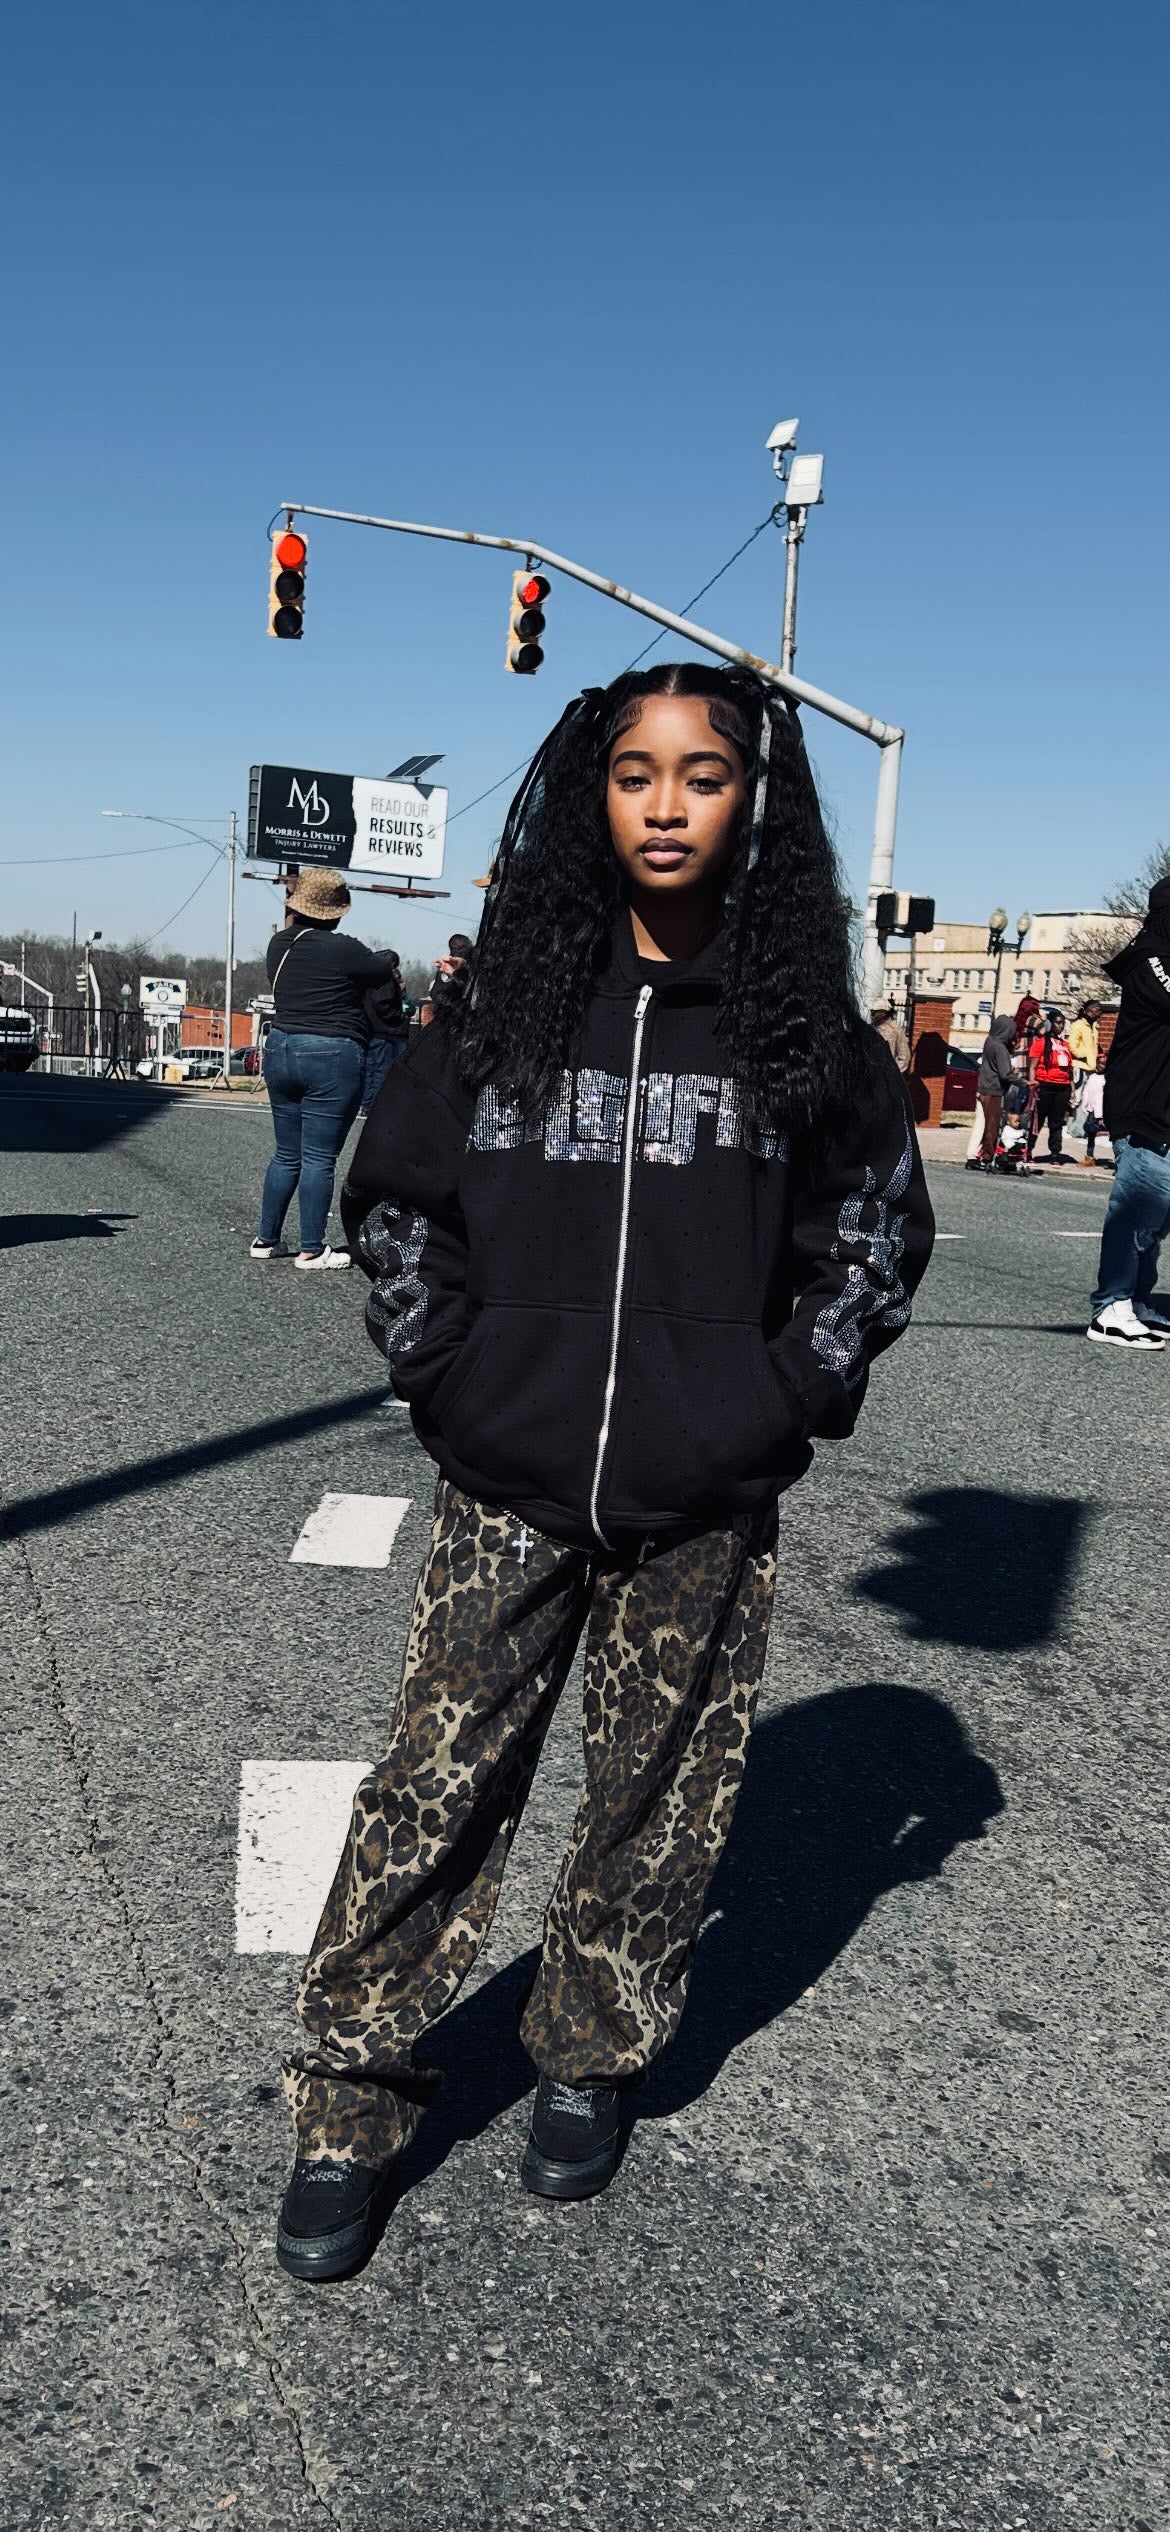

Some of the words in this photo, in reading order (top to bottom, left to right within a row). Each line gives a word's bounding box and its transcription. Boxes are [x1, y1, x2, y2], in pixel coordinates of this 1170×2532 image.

[371, 797, 401, 815] READ
[404, 801, 429, 818] OUR
[265, 826, 301, 838] MORRIS
[310, 830, 347, 843] DEWETT
[370, 817, 423, 838] RESULTS
[428, 824, 438, 839] &
[275, 839, 301, 848] INJURY
[303, 841, 337, 851] LAWYERS
[369, 837, 423, 858] REVIEWS
